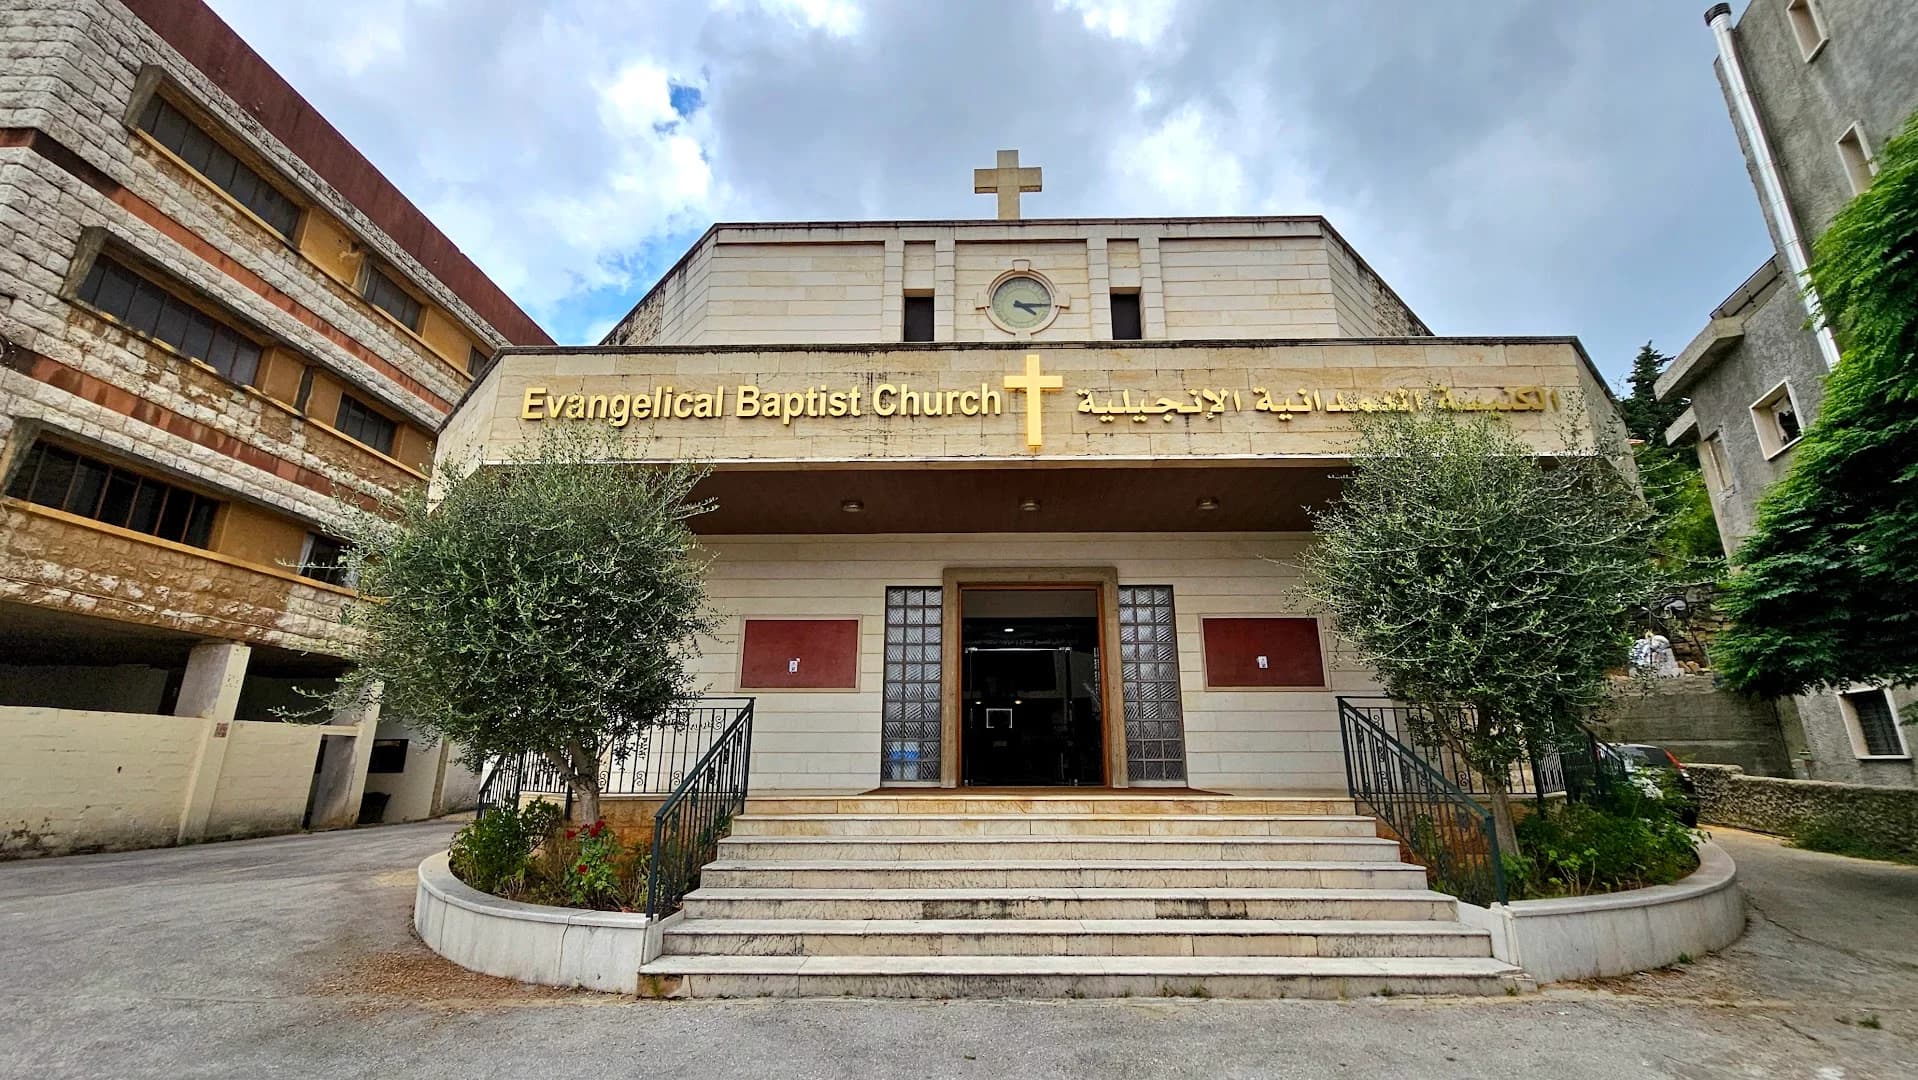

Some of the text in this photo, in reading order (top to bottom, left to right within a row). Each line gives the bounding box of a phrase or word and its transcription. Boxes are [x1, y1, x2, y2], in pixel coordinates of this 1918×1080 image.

[521, 382, 1001, 428] Evangelical Baptist Church
[1075, 387, 1242, 423] الإنجيلية
